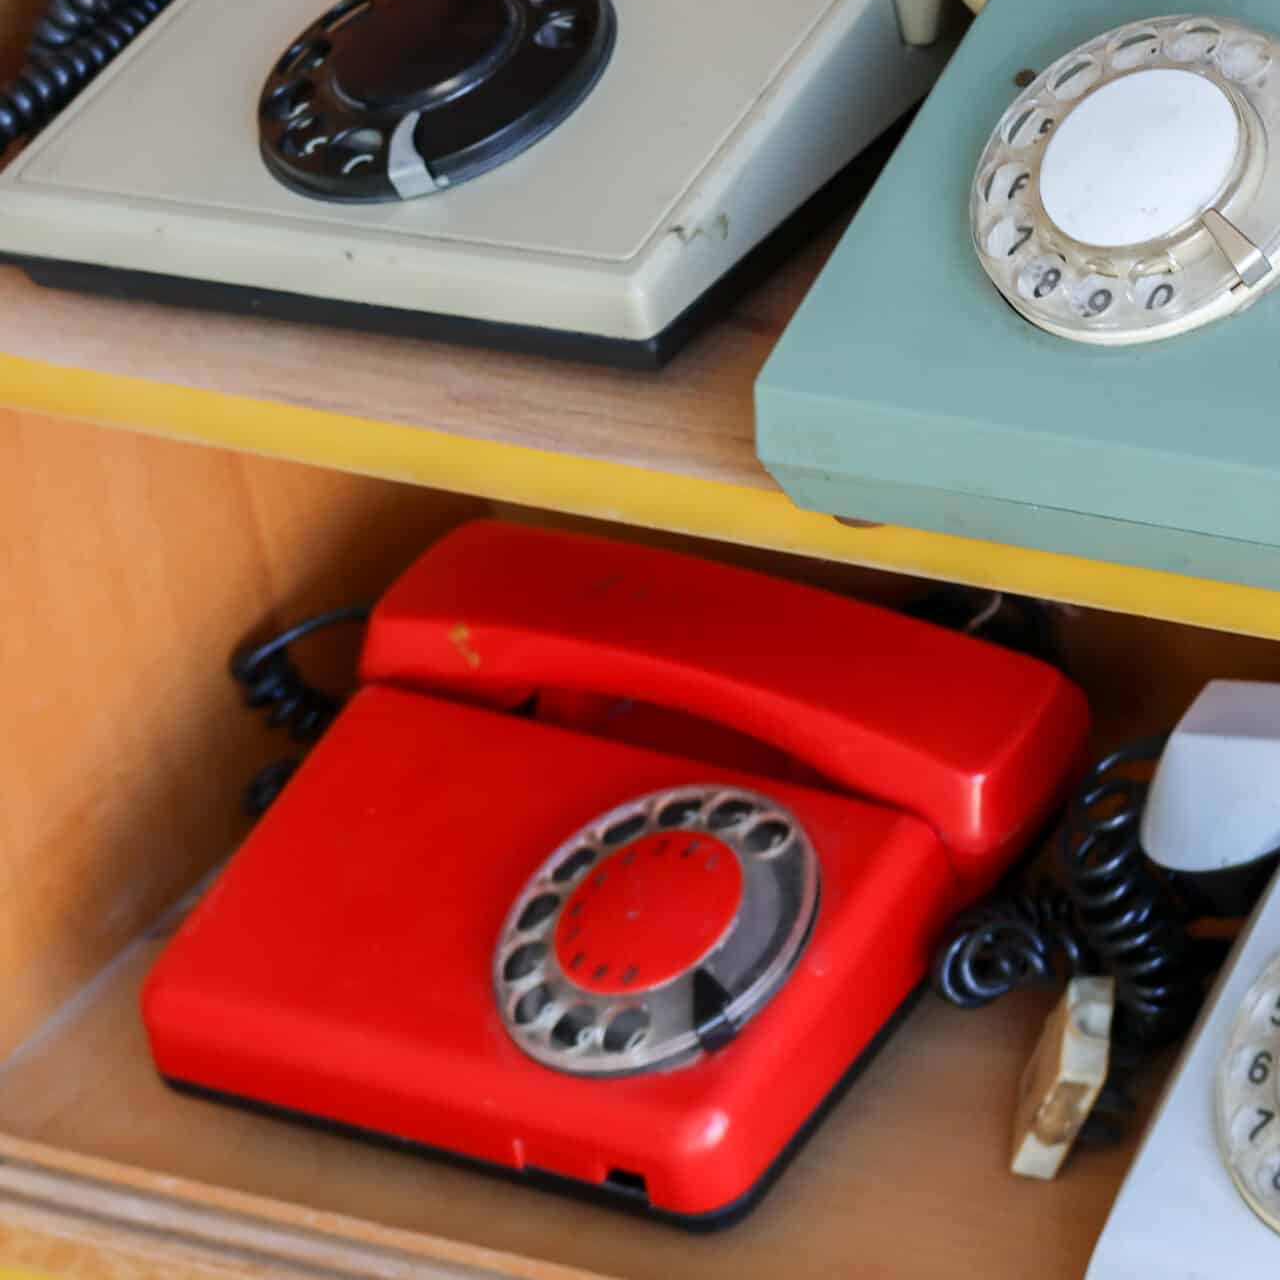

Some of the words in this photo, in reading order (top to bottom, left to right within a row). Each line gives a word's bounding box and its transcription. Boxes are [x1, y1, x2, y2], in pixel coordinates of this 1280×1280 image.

[1007, 225, 1033, 256] 7
[1082, 288, 1113, 318] 9
[1248, 1051, 1273, 1085] 6
[1249, 1108, 1275, 1142] 7
